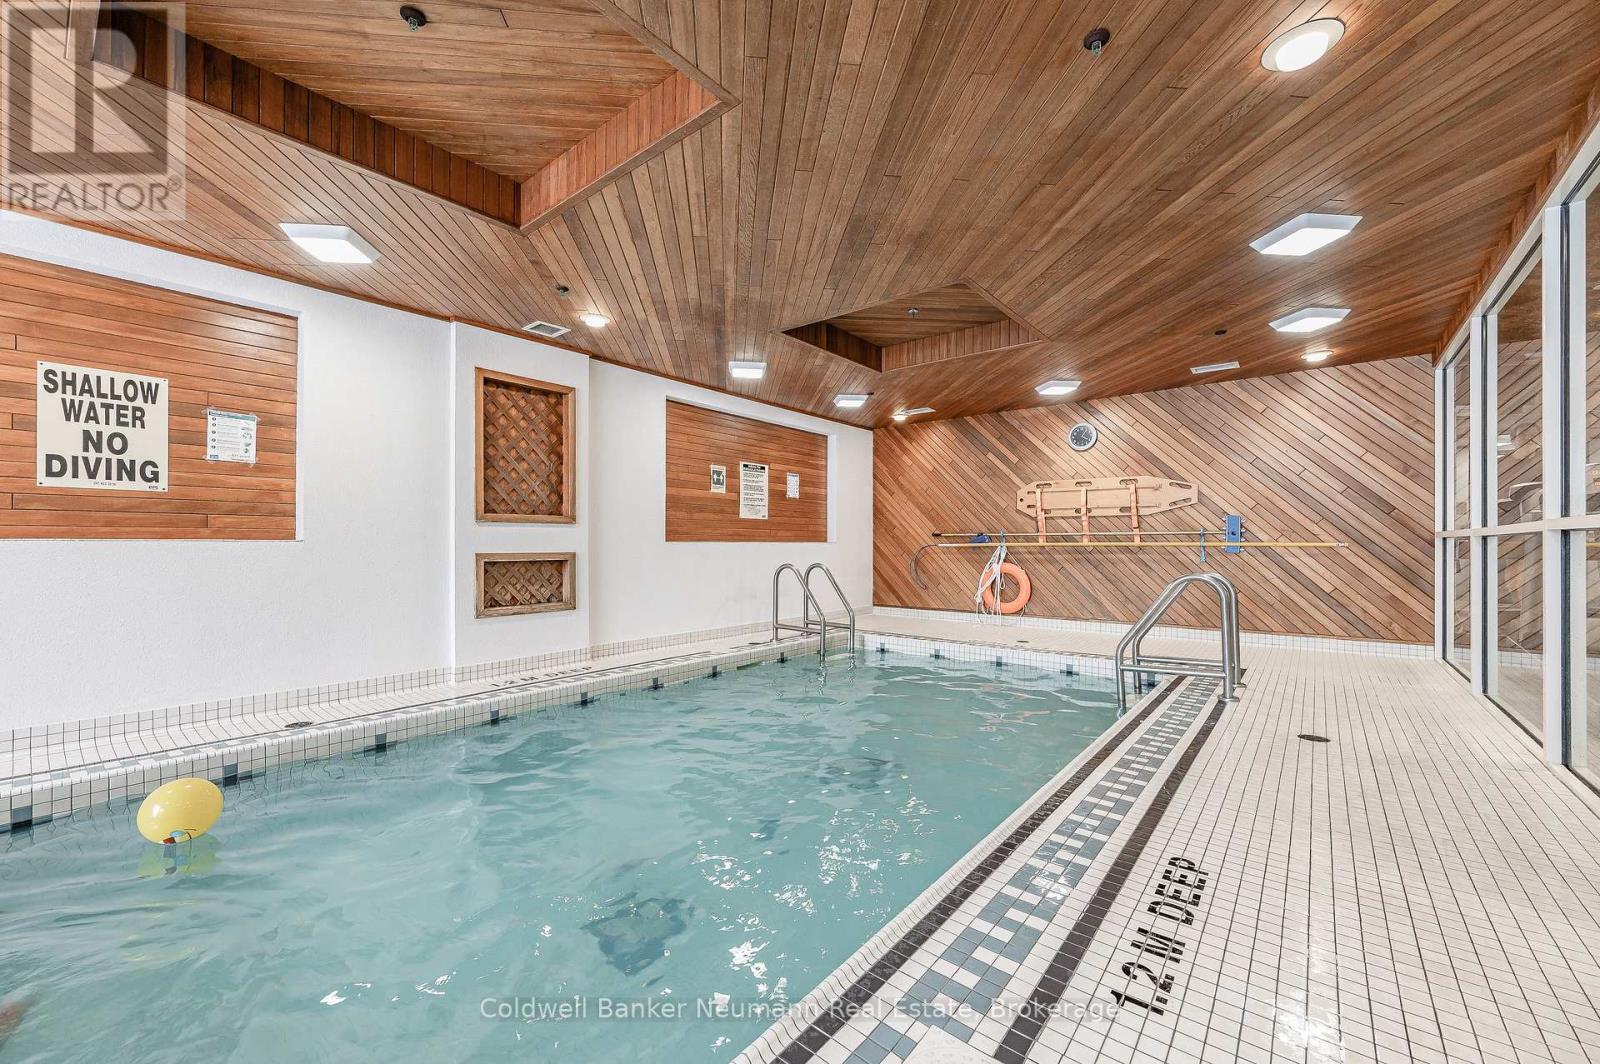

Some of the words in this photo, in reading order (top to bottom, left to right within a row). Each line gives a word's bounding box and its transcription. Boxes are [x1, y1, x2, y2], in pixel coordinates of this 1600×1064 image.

[43, 368, 160, 405] SHALLOW
[61, 397, 146, 430] WATER
[82, 429, 128, 456] NO
[45, 453, 160, 484] DIVING
[1147, 856, 1209, 926] DEEP
